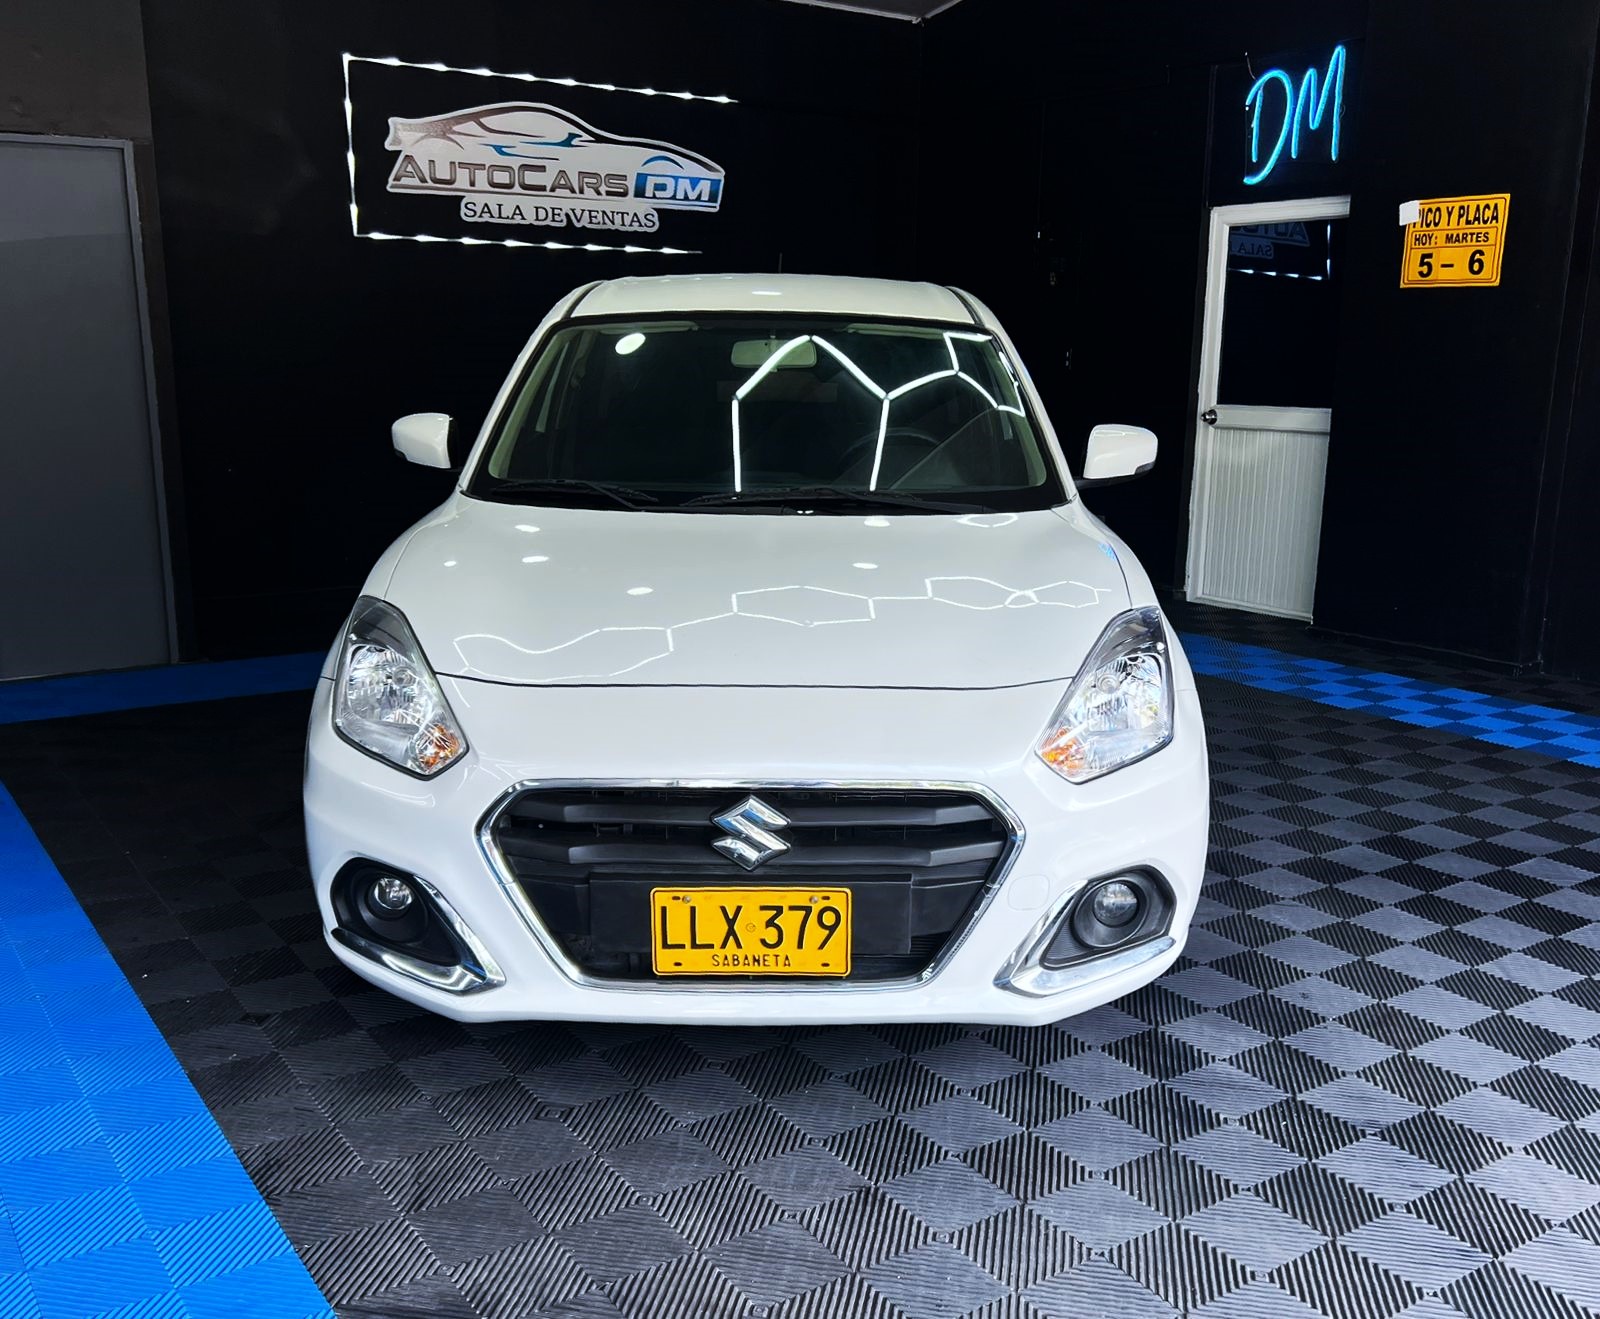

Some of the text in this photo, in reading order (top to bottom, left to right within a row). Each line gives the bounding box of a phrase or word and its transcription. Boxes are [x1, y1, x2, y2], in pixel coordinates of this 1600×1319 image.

[1243, 45, 1346, 185] DM
[392, 154, 711, 201] AUTOCARS DM
[463, 201, 656, 228] SALA DE VENTAS
[1446, 206, 1455, 227] Y
[1457, 202, 1499, 226] PLACA
[1413, 232, 1490, 246] HOY: MARTES
[1417, 252, 1434, 278] 5
[1467, 249, 1486, 276] 6
[660, 905, 842, 950] LLX 379
[711, 954, 791, 967] SABANETA
